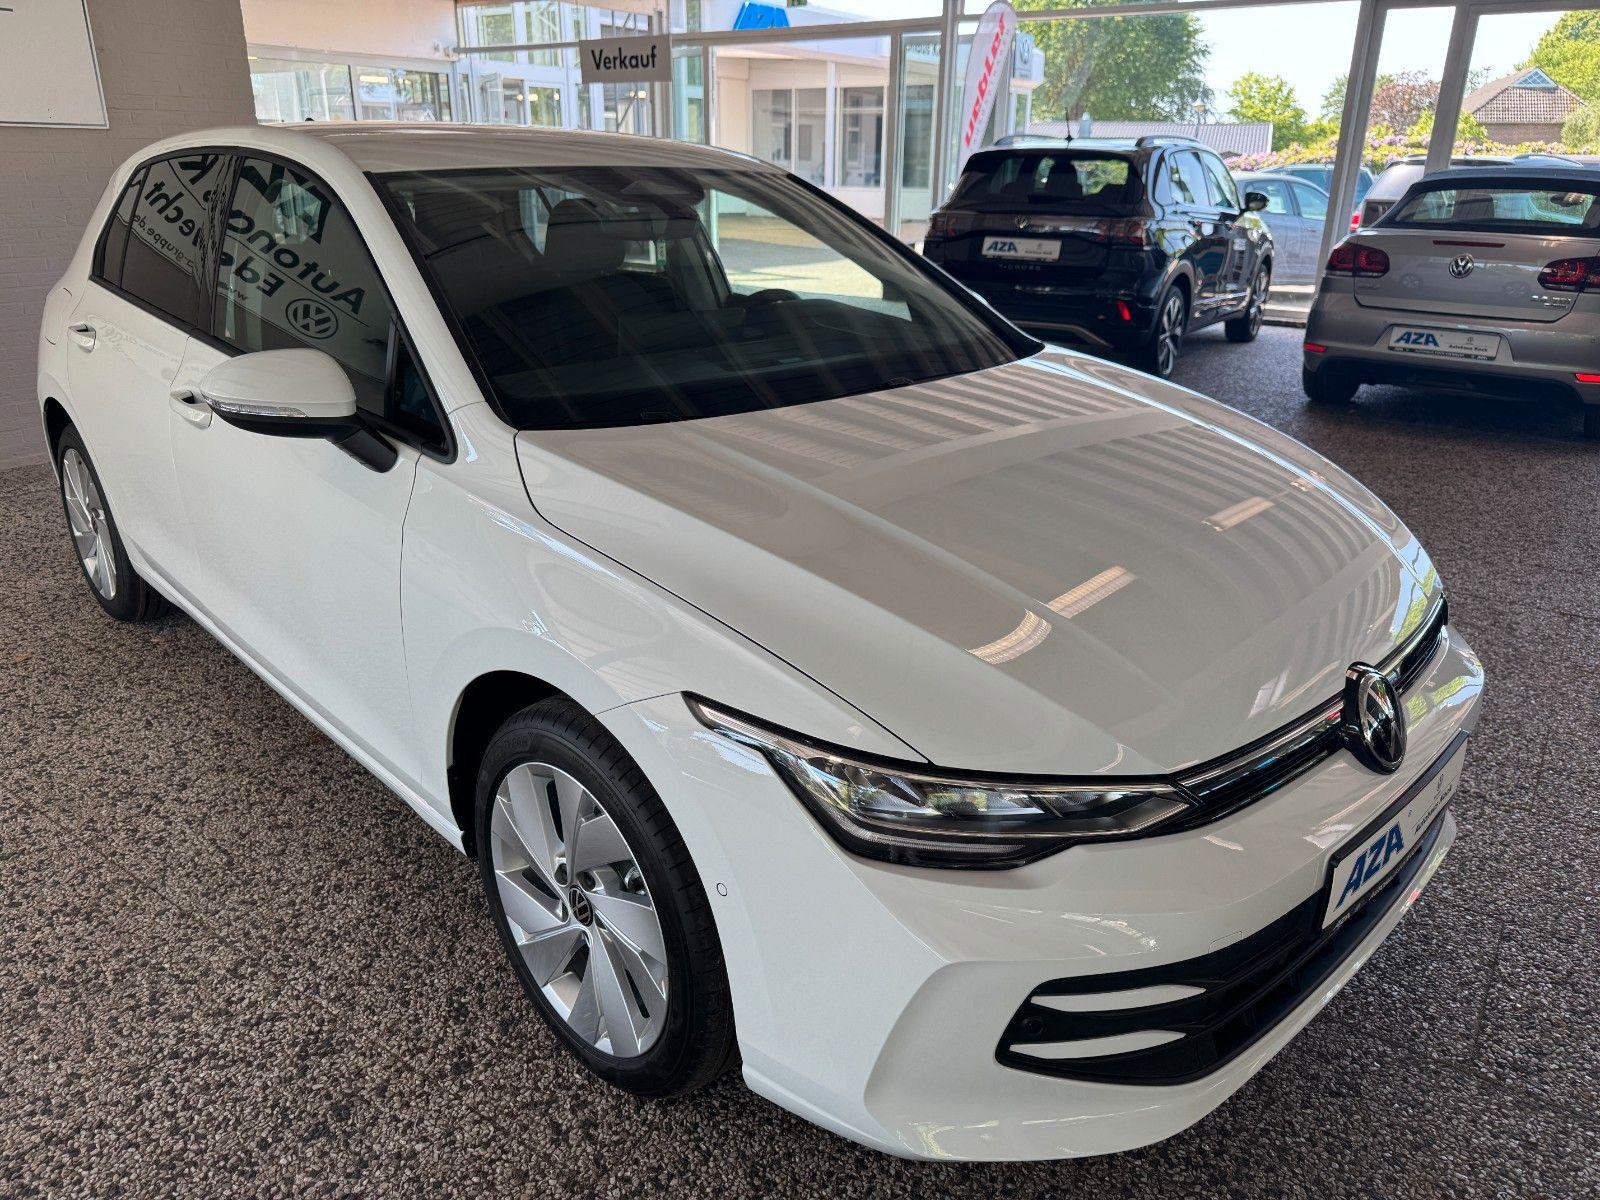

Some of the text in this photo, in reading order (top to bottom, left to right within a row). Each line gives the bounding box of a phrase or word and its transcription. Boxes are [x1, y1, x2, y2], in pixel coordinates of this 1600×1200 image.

[591, 45, 657, 70] Verkauf
[986, 241, 1018, 253] AZA
[1394, 331, 1440, 347] AZA
[1333, 821, 1404, 912] AZA
